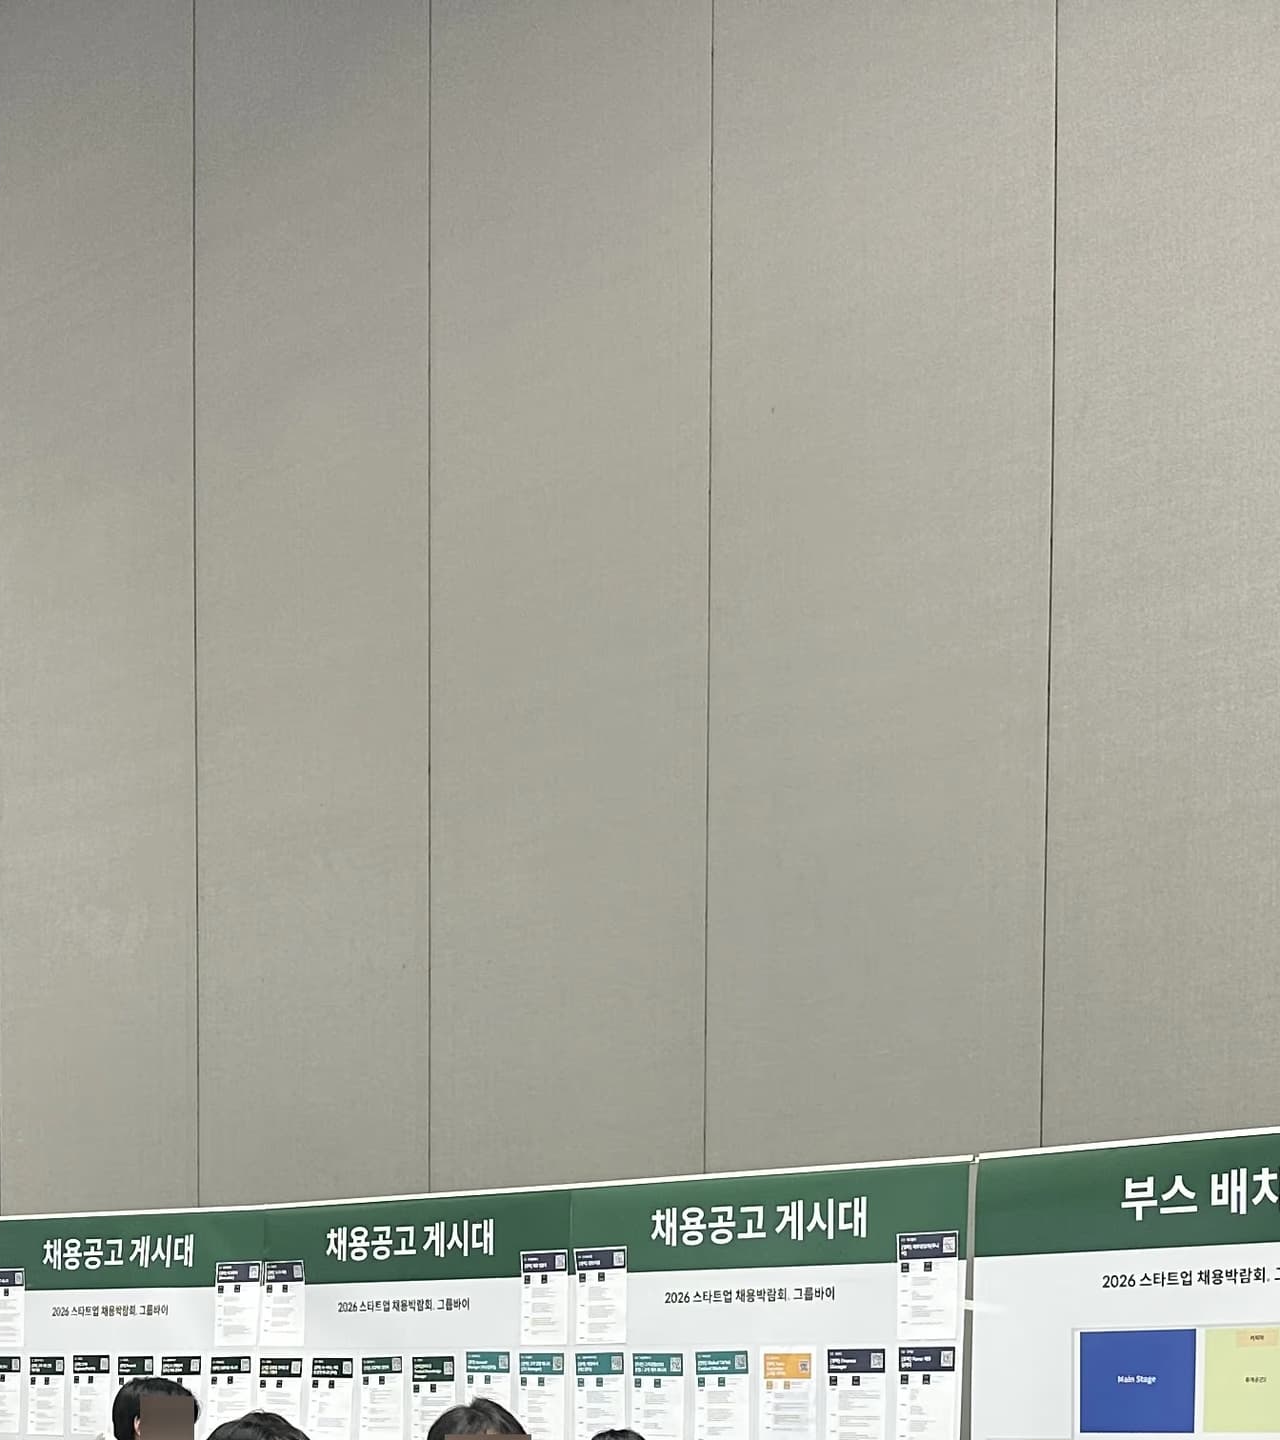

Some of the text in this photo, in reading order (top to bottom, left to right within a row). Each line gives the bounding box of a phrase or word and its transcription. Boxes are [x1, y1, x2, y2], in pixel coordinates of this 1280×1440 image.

[1121, 1175, 1197, 1221] 부스
[651, 1197, 866, 1246] 채용공고 게시대
[43, 1234, 193, 1270] 채용공고 게시대
[326, 1219, 493, 1261] 채용공고 게시대
[1102, 1274, 1135, 1288] 2026
[1140, 1270, 1192, 1287] 스타트업
[338, 1302, 357, 1312] 2026
[360, 1300, 390, 1312] 스타트업
[437, 1298, 469, 1311] 그룹바이
[665, 1292, 690, 1303] 2026
[693, 1290, 732, 1303] 스타트업
[793, 1286, 834, 1301] 그룹바이
[1136, 1375, 1156, 1384] Stage
